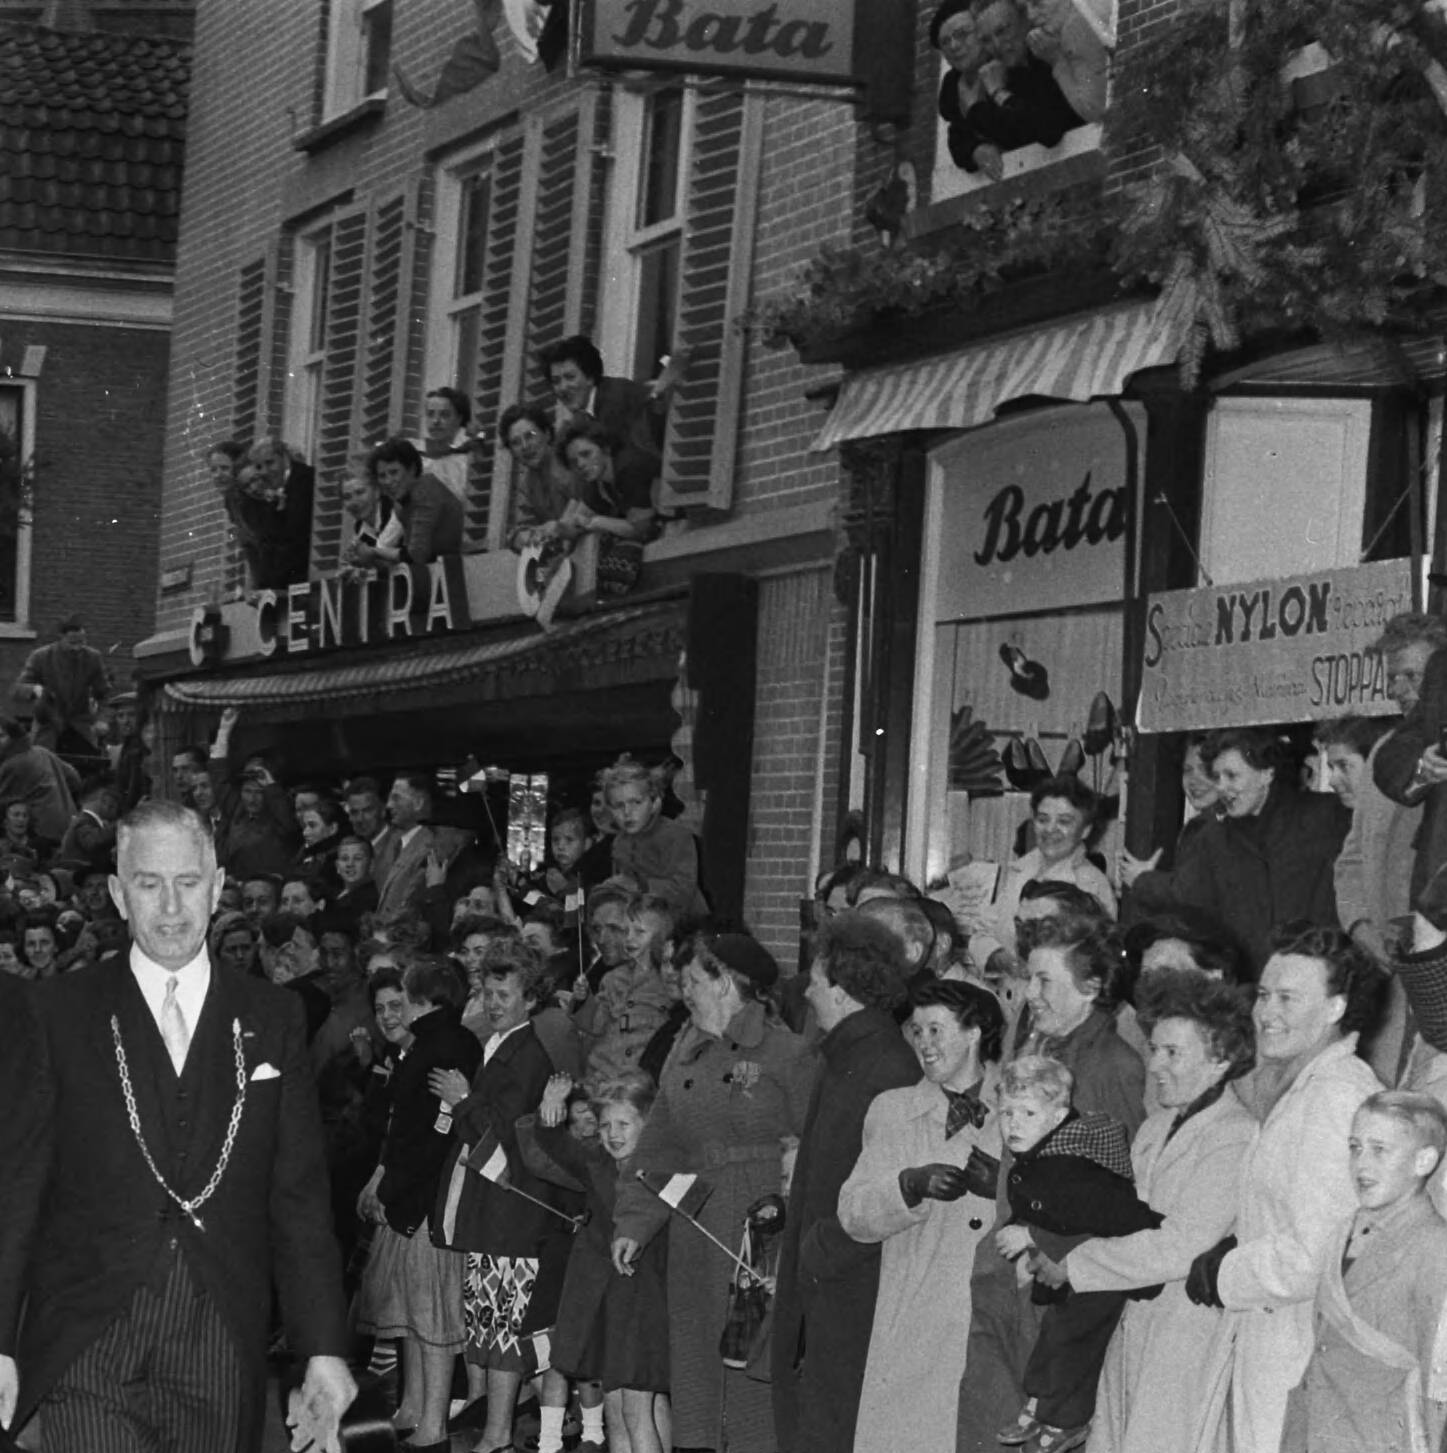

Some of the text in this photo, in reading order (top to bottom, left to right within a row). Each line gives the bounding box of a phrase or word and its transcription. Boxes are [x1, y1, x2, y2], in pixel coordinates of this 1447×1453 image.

[612, 0, 833, 58] Bata
[973, 472, 1126, 566] Bata
[257, 555, 453, 656] CENTRA
[1215, 582, 1331, 646] NYLON
